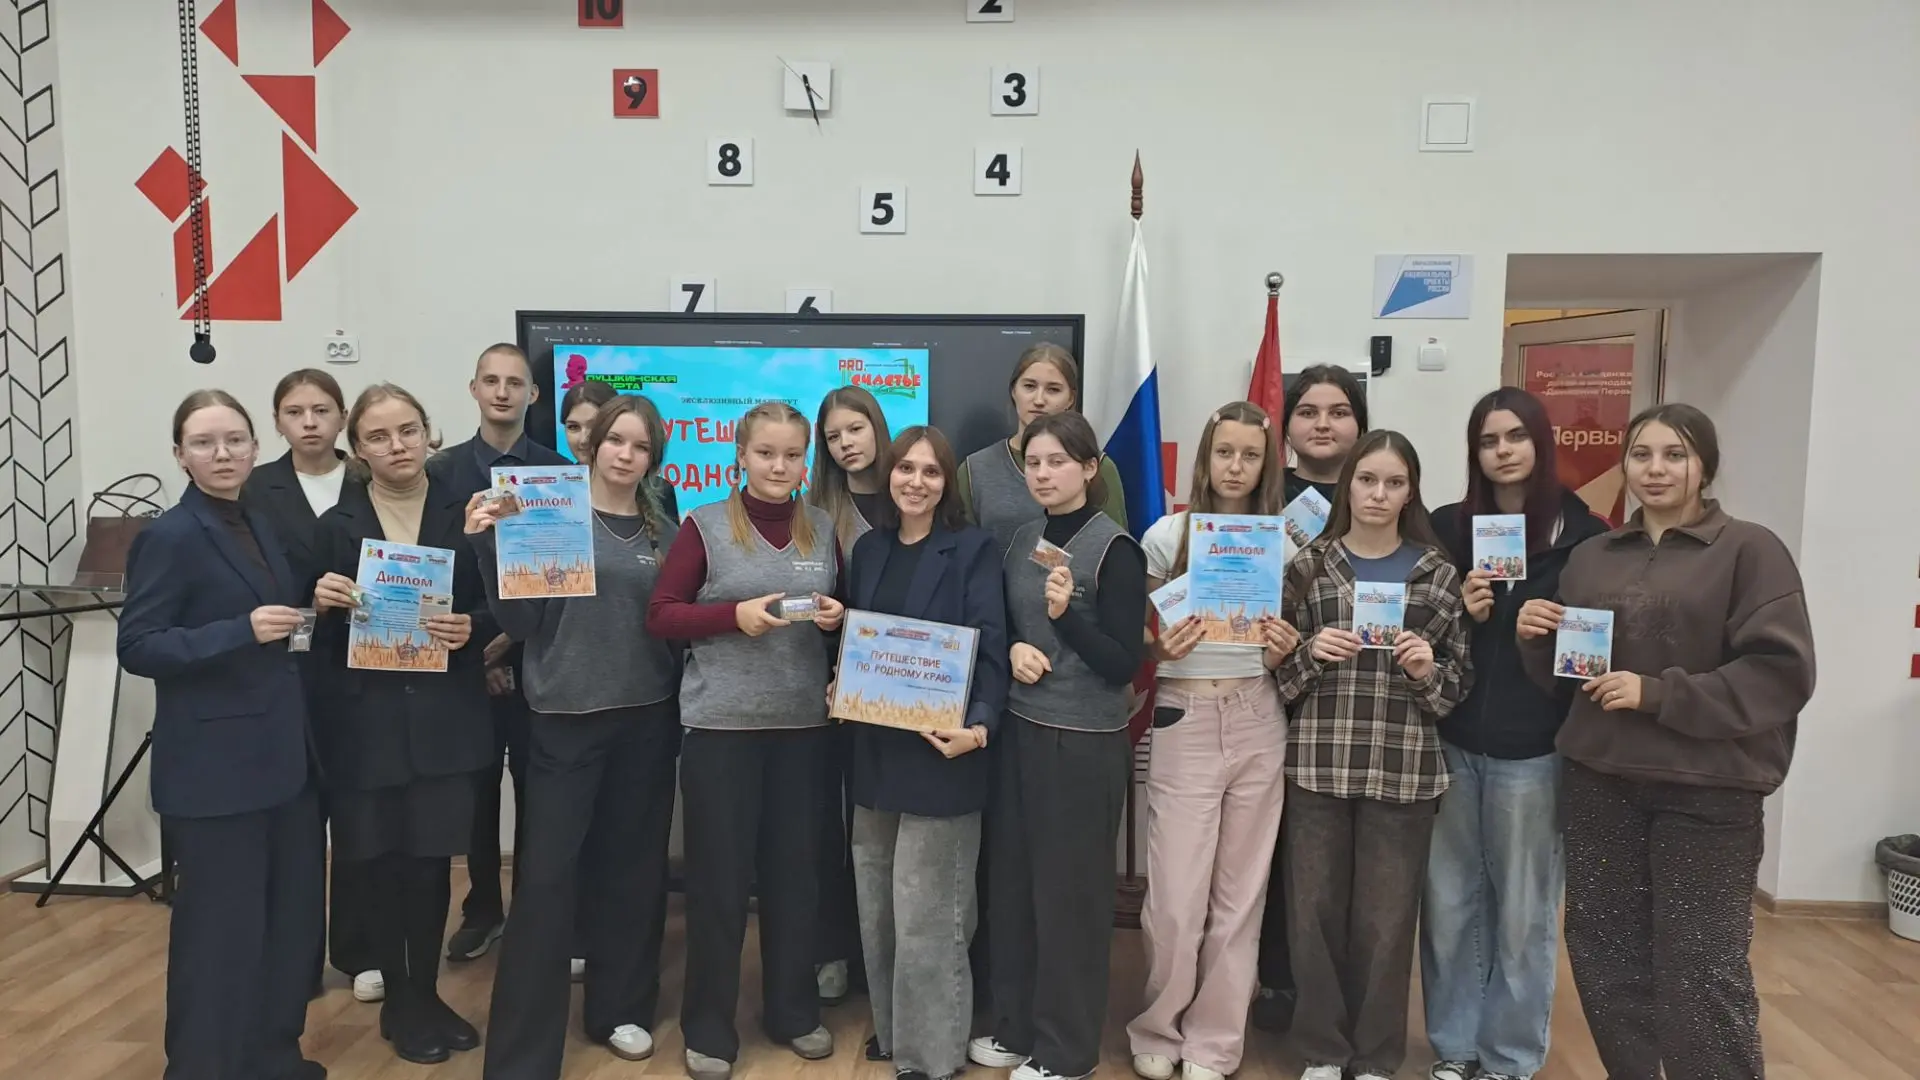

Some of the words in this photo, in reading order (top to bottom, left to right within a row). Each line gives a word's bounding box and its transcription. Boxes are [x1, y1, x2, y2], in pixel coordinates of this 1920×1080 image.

[623, 76, 648, 109] 9
[1002, 72, 1027, 107] 3
[717, 143, 742, 177] 8
[985, 153, 1011, 186] 4
[871, 192, 894, 226] 5
[682, 283, 706, 313] 7
[585, 374, 677, 383] ПУШКИНСКАЯ
[1552, 426, 1623, 451] Первы
[1208, 543, 1266, 555] Диплом
[376, 570, 433, 587] Диплом
[855, 660, 871, 672] ПО
[874, 663, 922, 679] РОДНОМУ
[923, 671, 952, 683] КРАЮ
[871, 649, 941, 668] ПУТЕШЕСТВИЕ
